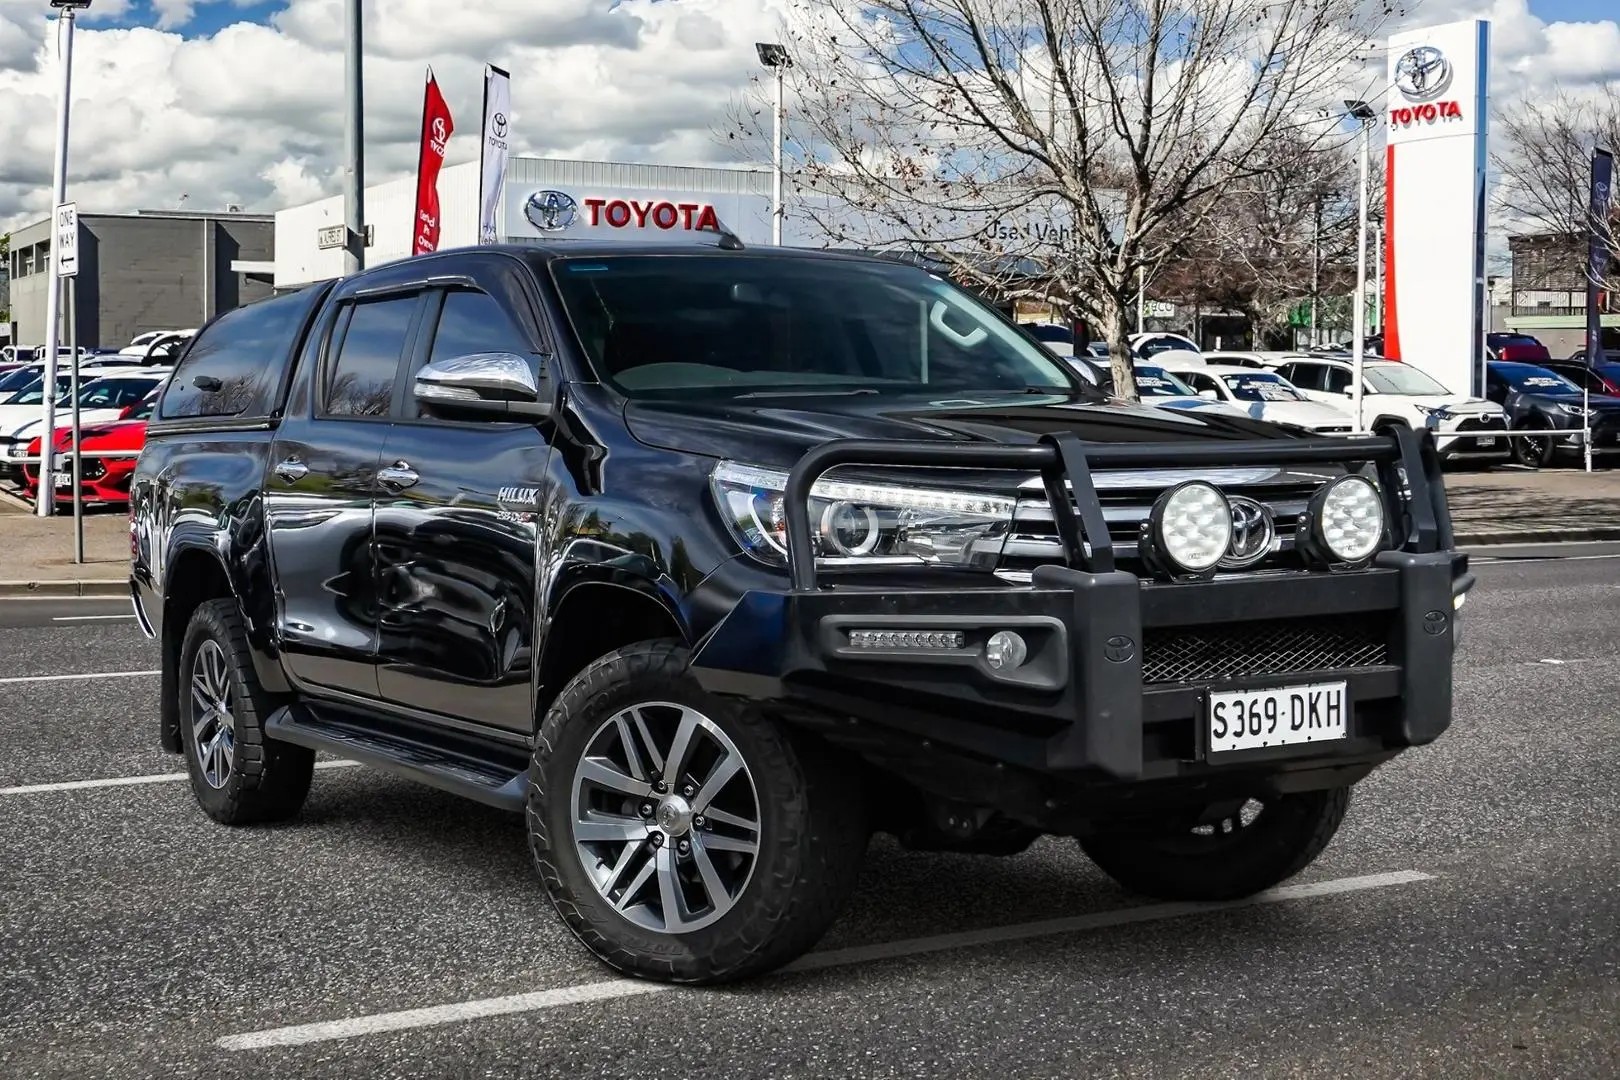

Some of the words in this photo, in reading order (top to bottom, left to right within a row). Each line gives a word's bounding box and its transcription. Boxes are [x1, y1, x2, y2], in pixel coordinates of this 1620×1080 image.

[1390, 101, 1463, 125] TOYOTA
[60, 209, 74, 227] ONE
[584, 199, 720, 231] TOYOTA
[60, 231, 75, 248] WAY
[986, 219, 1030, 240] Used
[1035, 223, 1070, 241] Veh
[497, 487, 539, 505] HILUX
